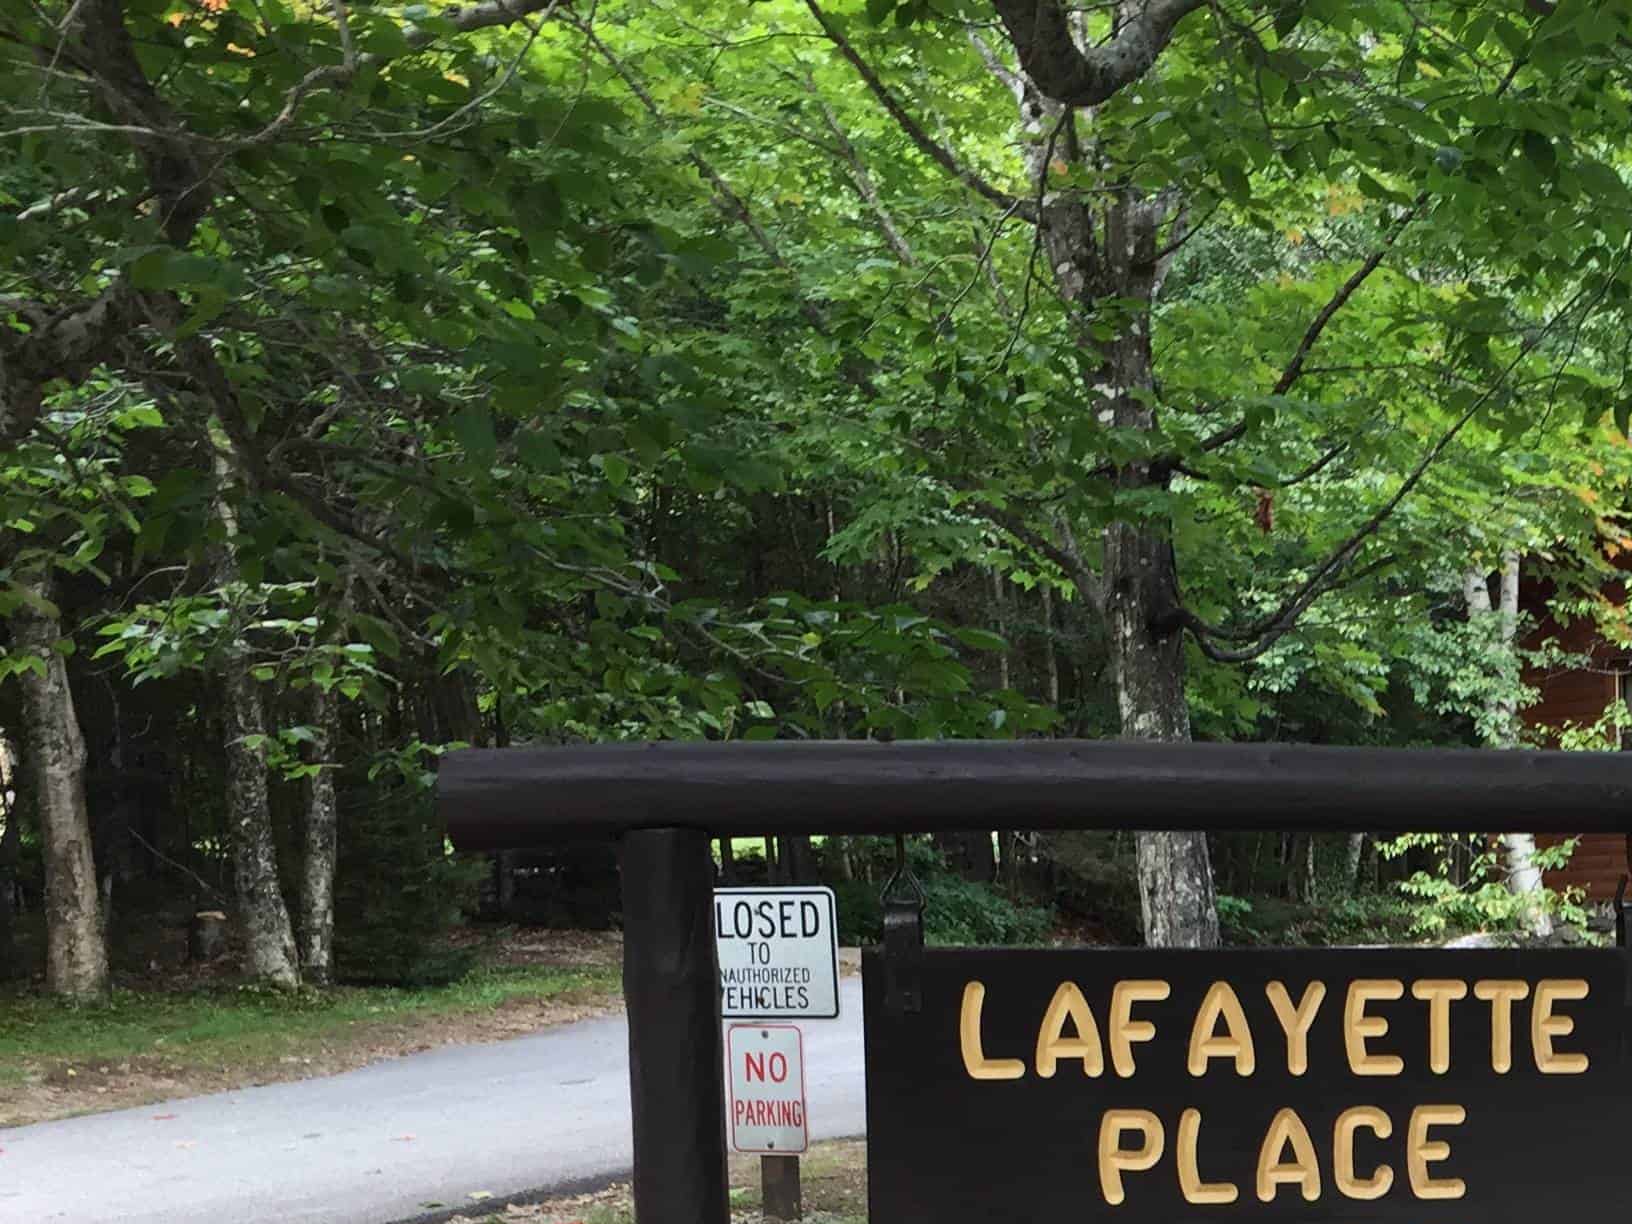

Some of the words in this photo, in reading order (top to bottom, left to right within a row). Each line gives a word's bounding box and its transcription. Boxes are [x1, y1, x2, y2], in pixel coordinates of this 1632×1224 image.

[715, 899, 820, 939] LOSED
[747, 941, 771, 966] TO
[720, 966, 811, 985] NAUTHORIZED
[721, 986, 810, 1010] EHICLES
[959, 979, 1590, 1081] LAFAYETTE
[744, 1052, 788, 1083] NO
[735, 1099, 802, 1127] PARKING
[1098, 1105, 1467, 1206] PLACE
